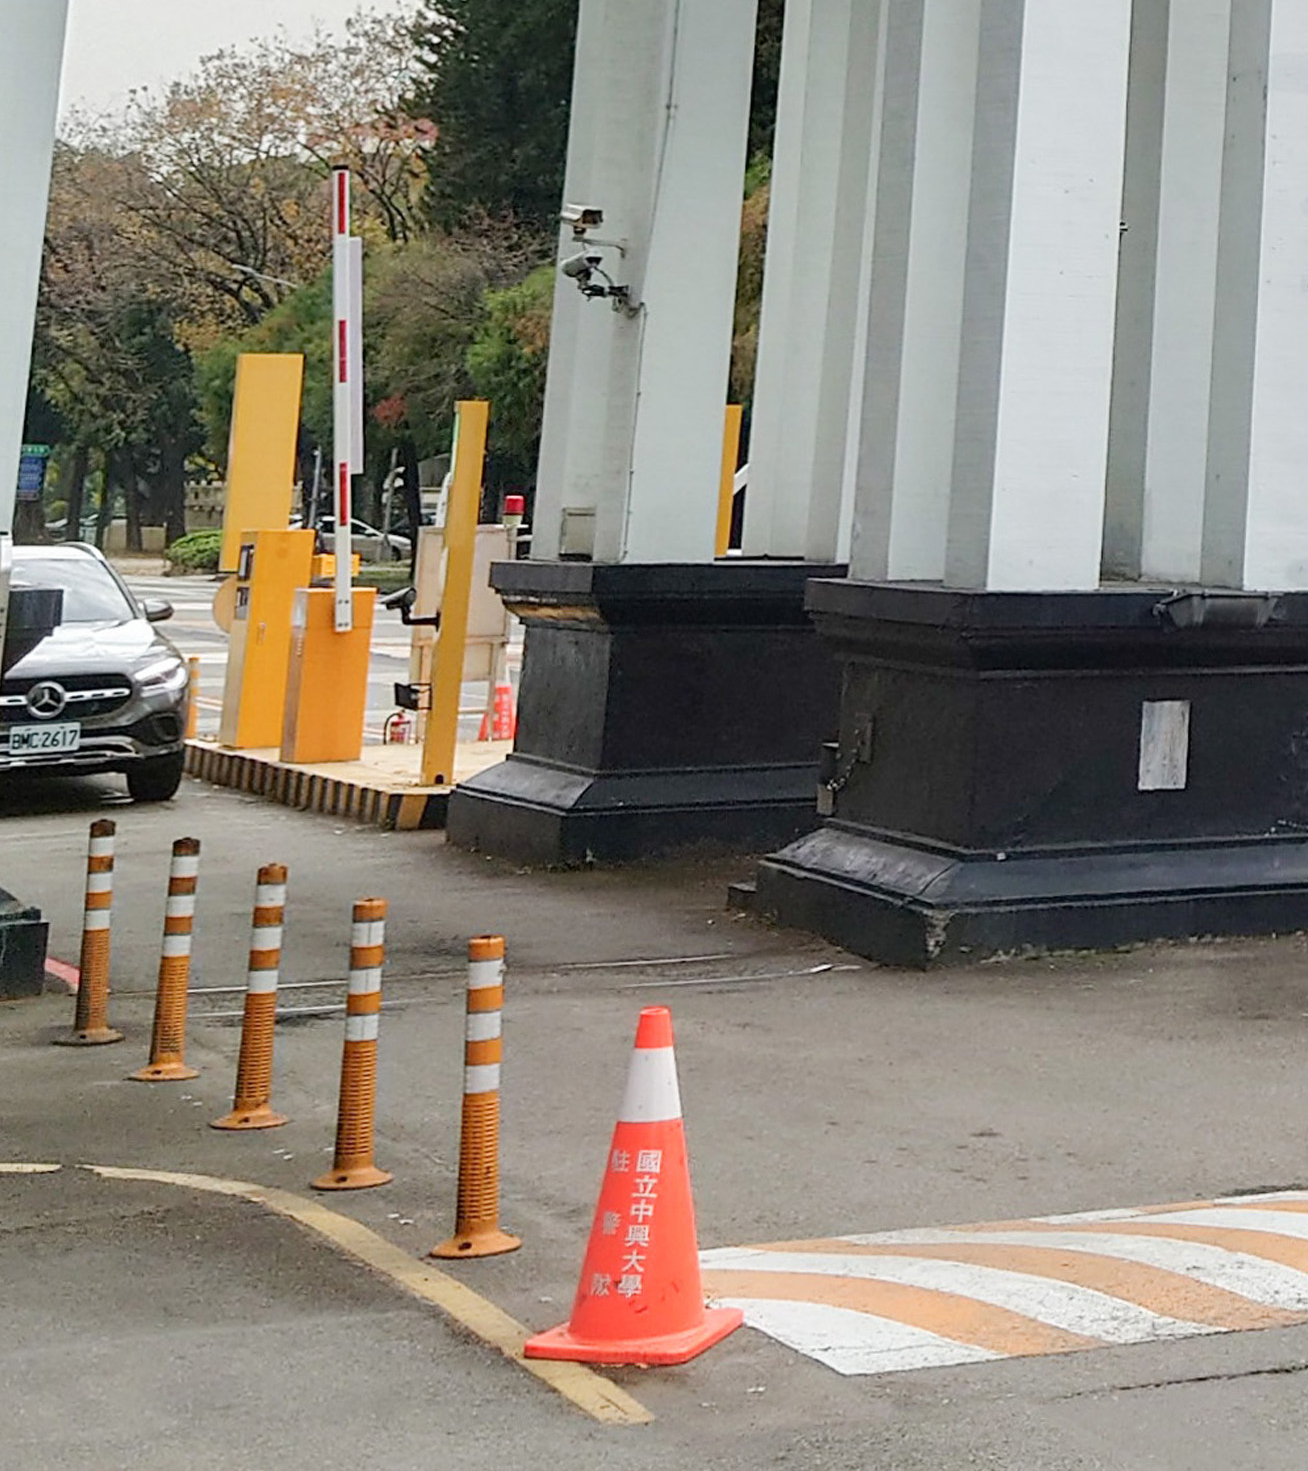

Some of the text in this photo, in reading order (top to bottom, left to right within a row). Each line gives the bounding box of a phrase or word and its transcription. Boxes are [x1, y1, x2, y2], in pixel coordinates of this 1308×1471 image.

[618, 1149, 662, 1298] 國立中興大學
